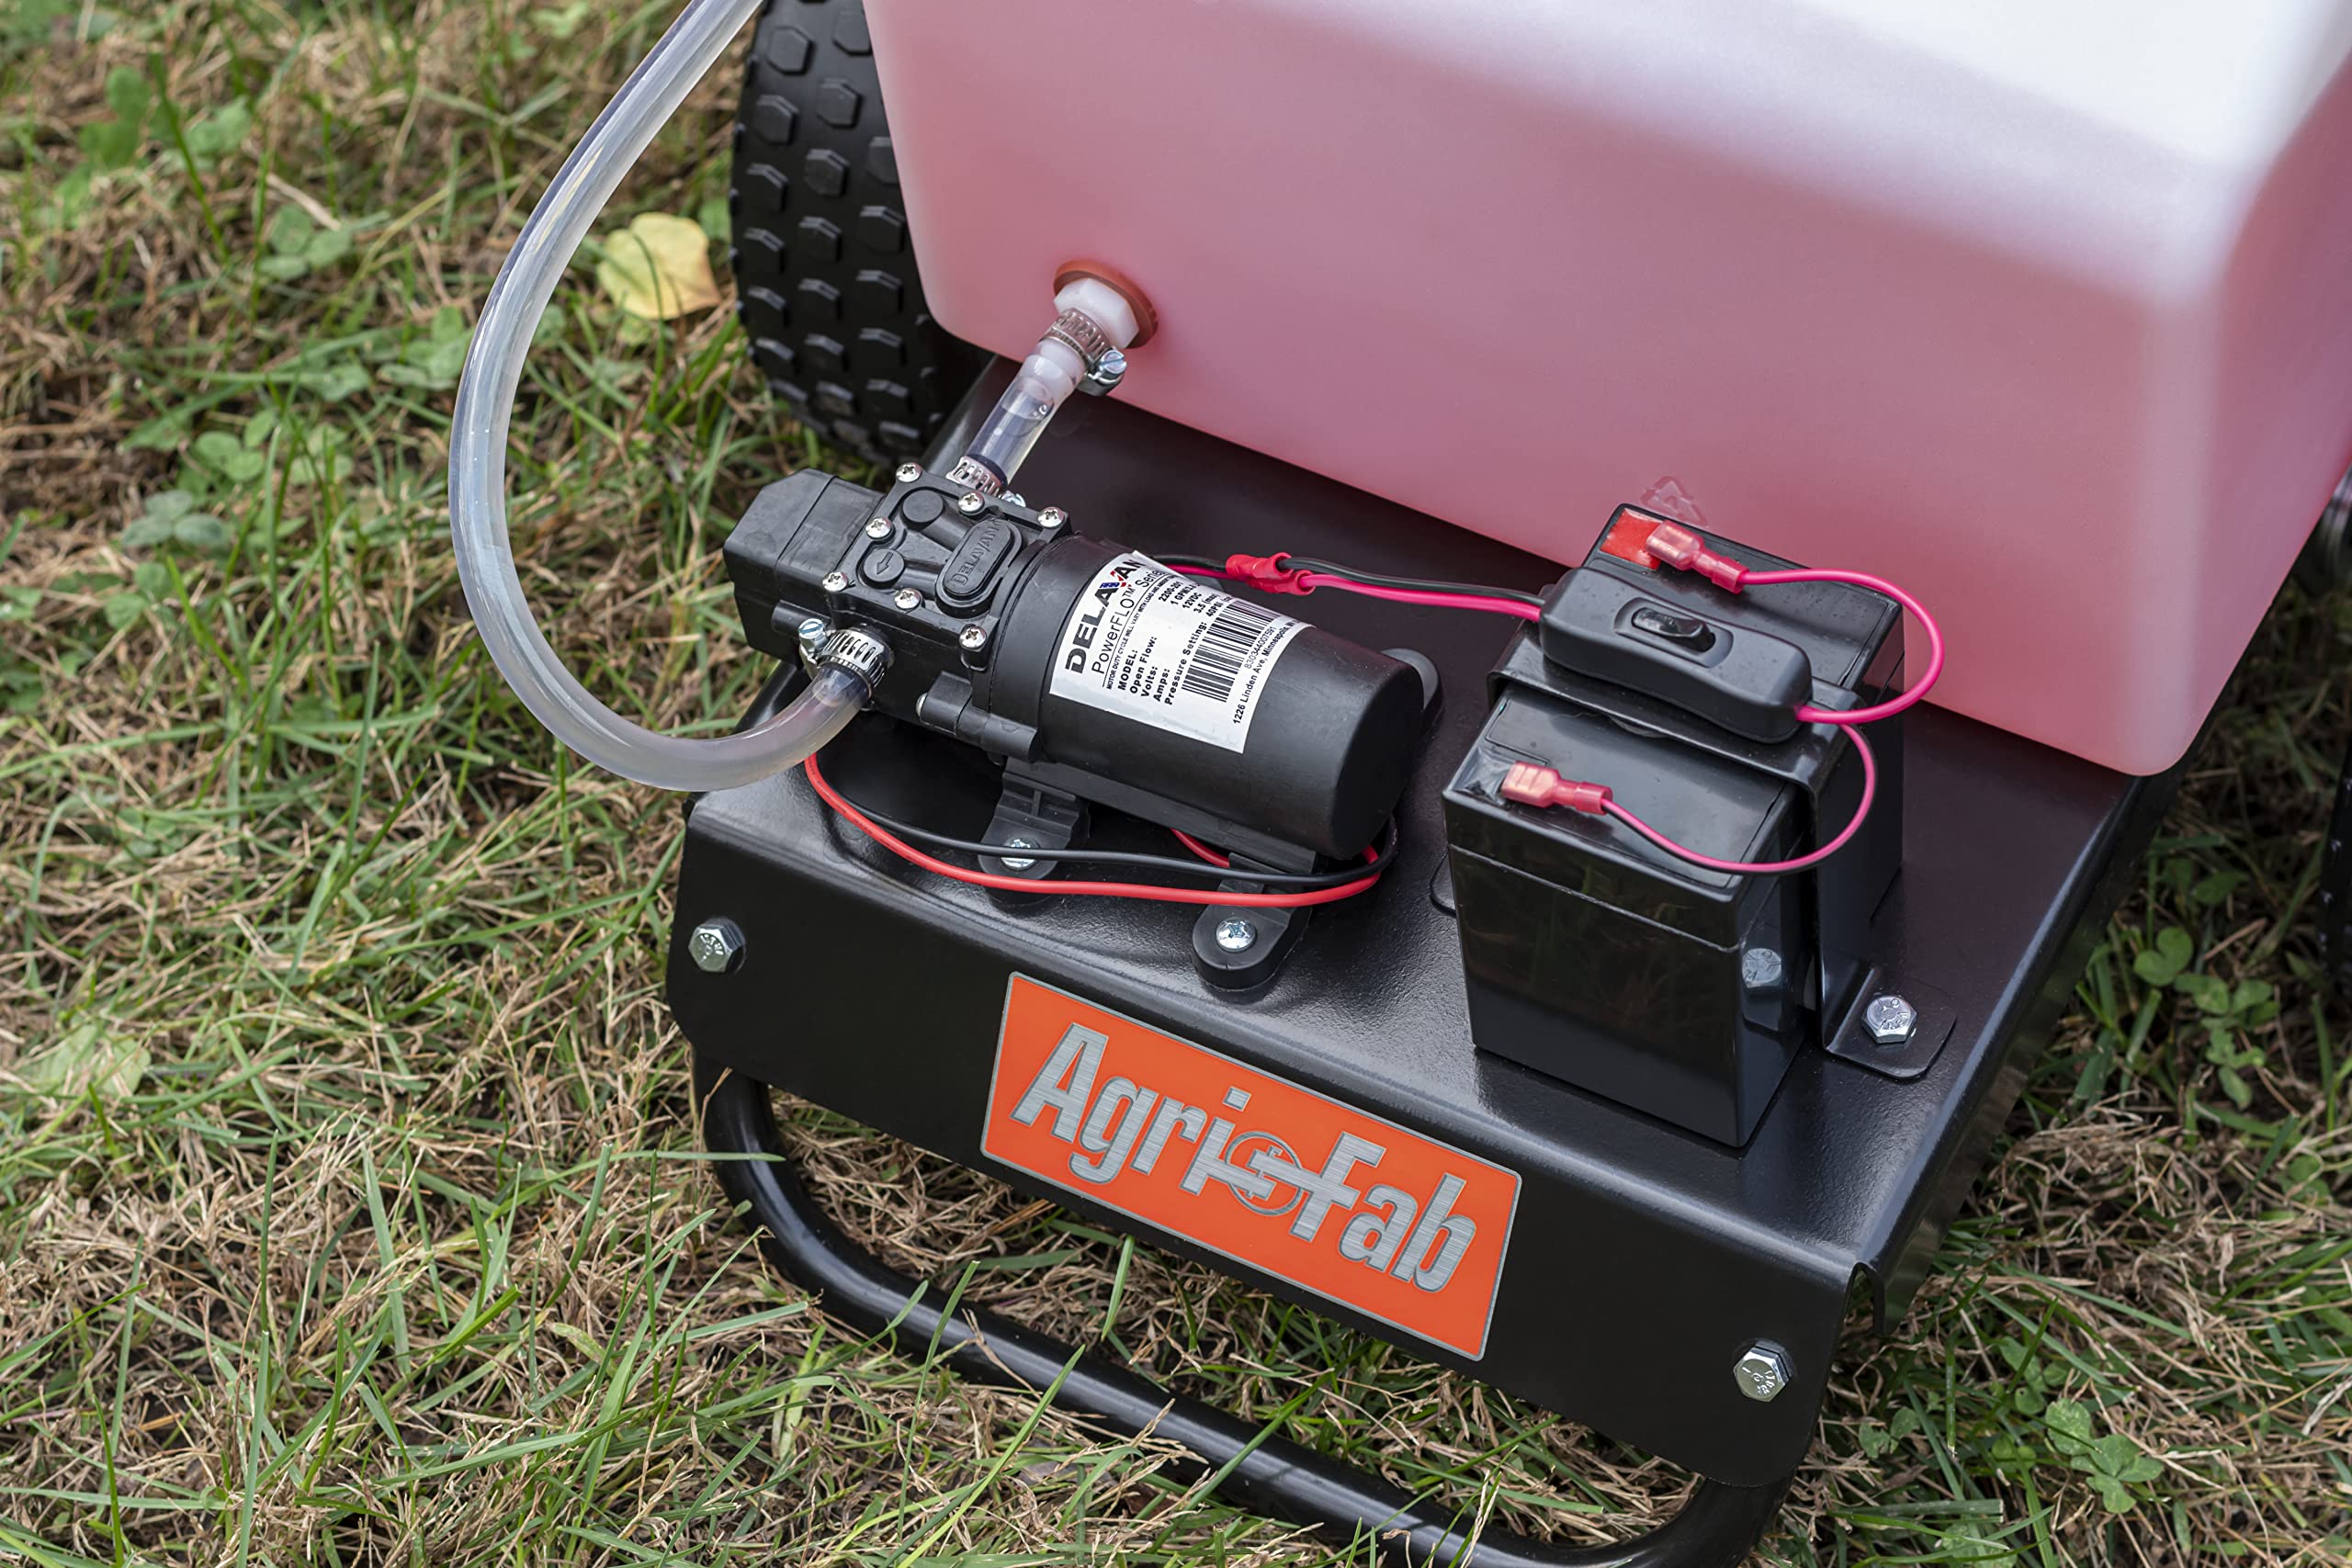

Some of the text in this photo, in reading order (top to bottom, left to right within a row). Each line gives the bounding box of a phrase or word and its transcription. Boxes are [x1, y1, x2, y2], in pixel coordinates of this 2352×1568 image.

[1065, 558, 1146, 673] DELAVAN
[1106, 670, 1116, 690] MOTOR
[1113, 655, 1121, 670] DUTY
[1118, 637, 1129, 655] CYCLE
[1125, 626, 1135, 637] WILL
[1131, 612, 1140, 626] VARY
[1117, 649, 1137, 691] MODEL:
[1130, 667, 1145, 694] Open
[1139, 636, 1157, 663] Flow:
[1141, 666, 1158, 697] Volts:
[1153, 668, 1170, 703] Amps:
[1193, 603, 1206, 614] 3.5
[1164, 659, 1187, 705] Pressure
[1183, 622, 1207, 656] Setting:
[1233, 704, 1246, 725] 1226
[1240, 674, 1258, 704] Linden
[1252, 658, 1268, 674] Ave,
